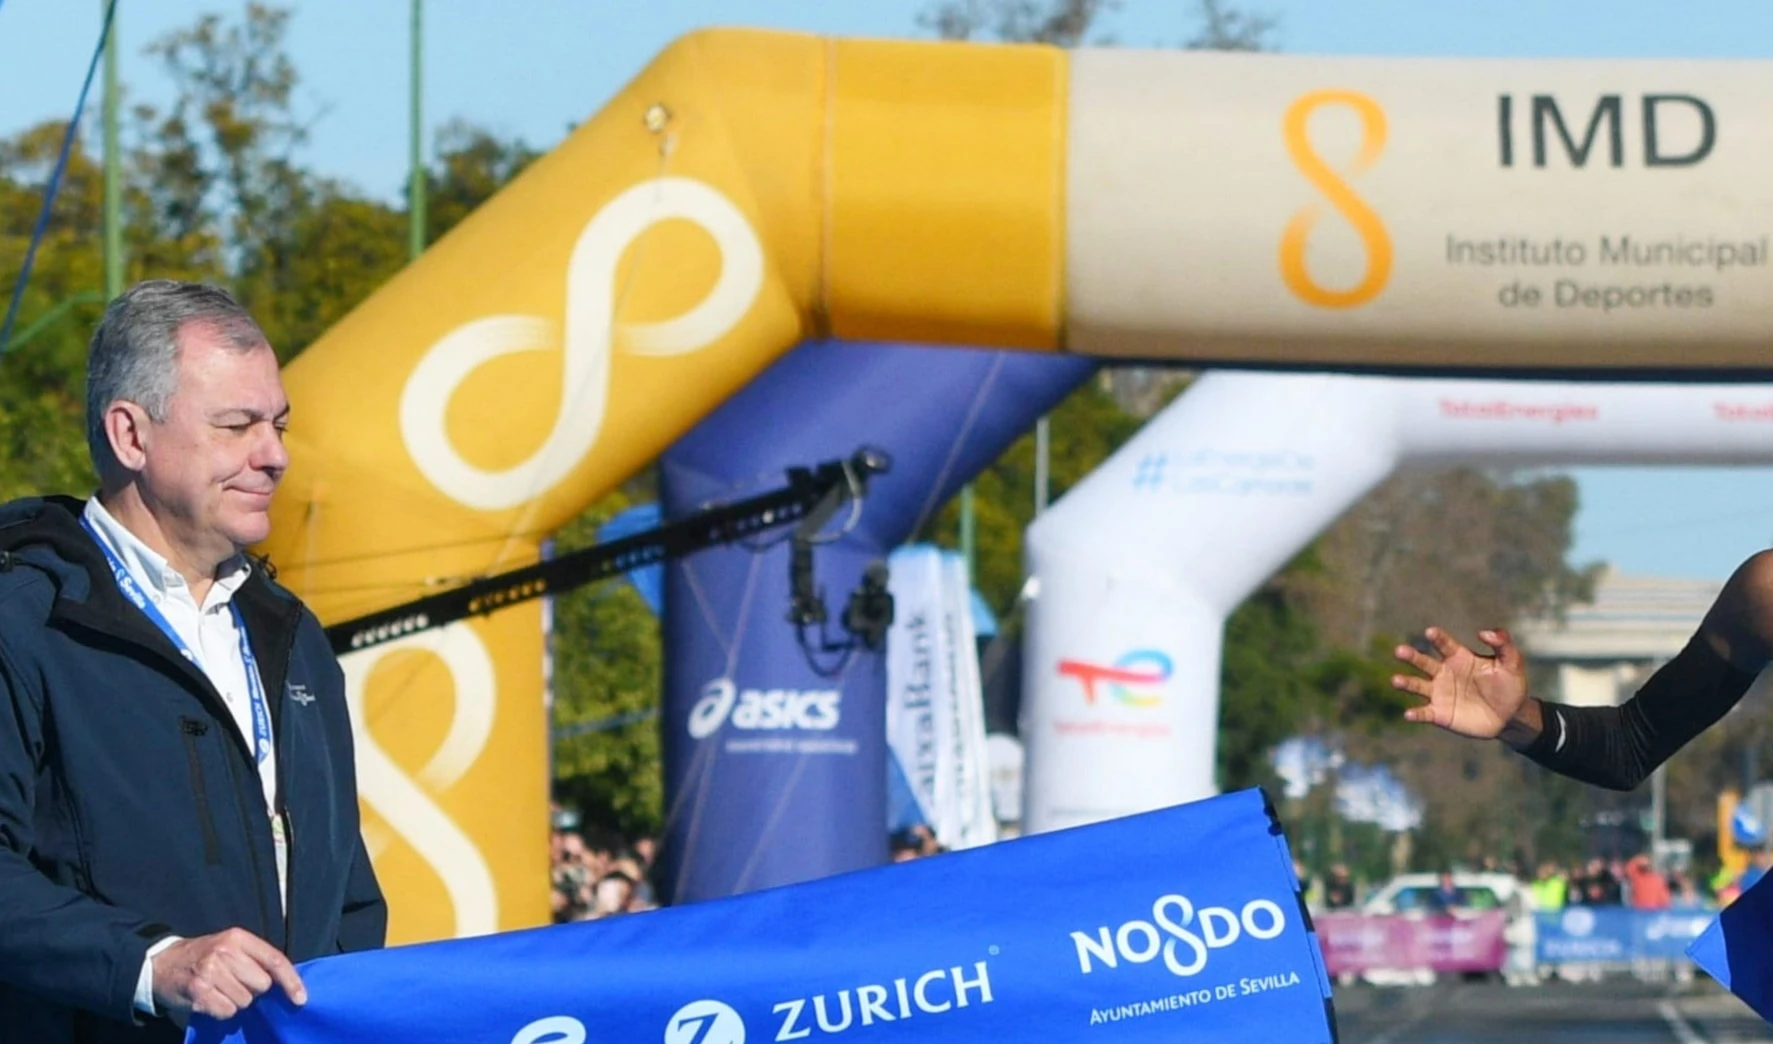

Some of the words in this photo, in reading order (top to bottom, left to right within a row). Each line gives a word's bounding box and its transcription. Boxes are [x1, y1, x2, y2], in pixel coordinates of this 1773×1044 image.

[1498, 94, 1718, 168] IMD
[1446, 235, 1586, 266] Instituto
[1600, 235, 1769, 270] Municipal
[1498, 281, 1542, 308] de
[1554, 280, 1715, 312] Deportes
[731, 689, 843, 731] asics
[772, 961, 994, 1042] ZURICH
[1090, 989, 1211, 1025] AYUNTAMIENTO
[1215, 983, 1237, 1000] DE
[1240, 972, 1300, 996] SEVILLA
